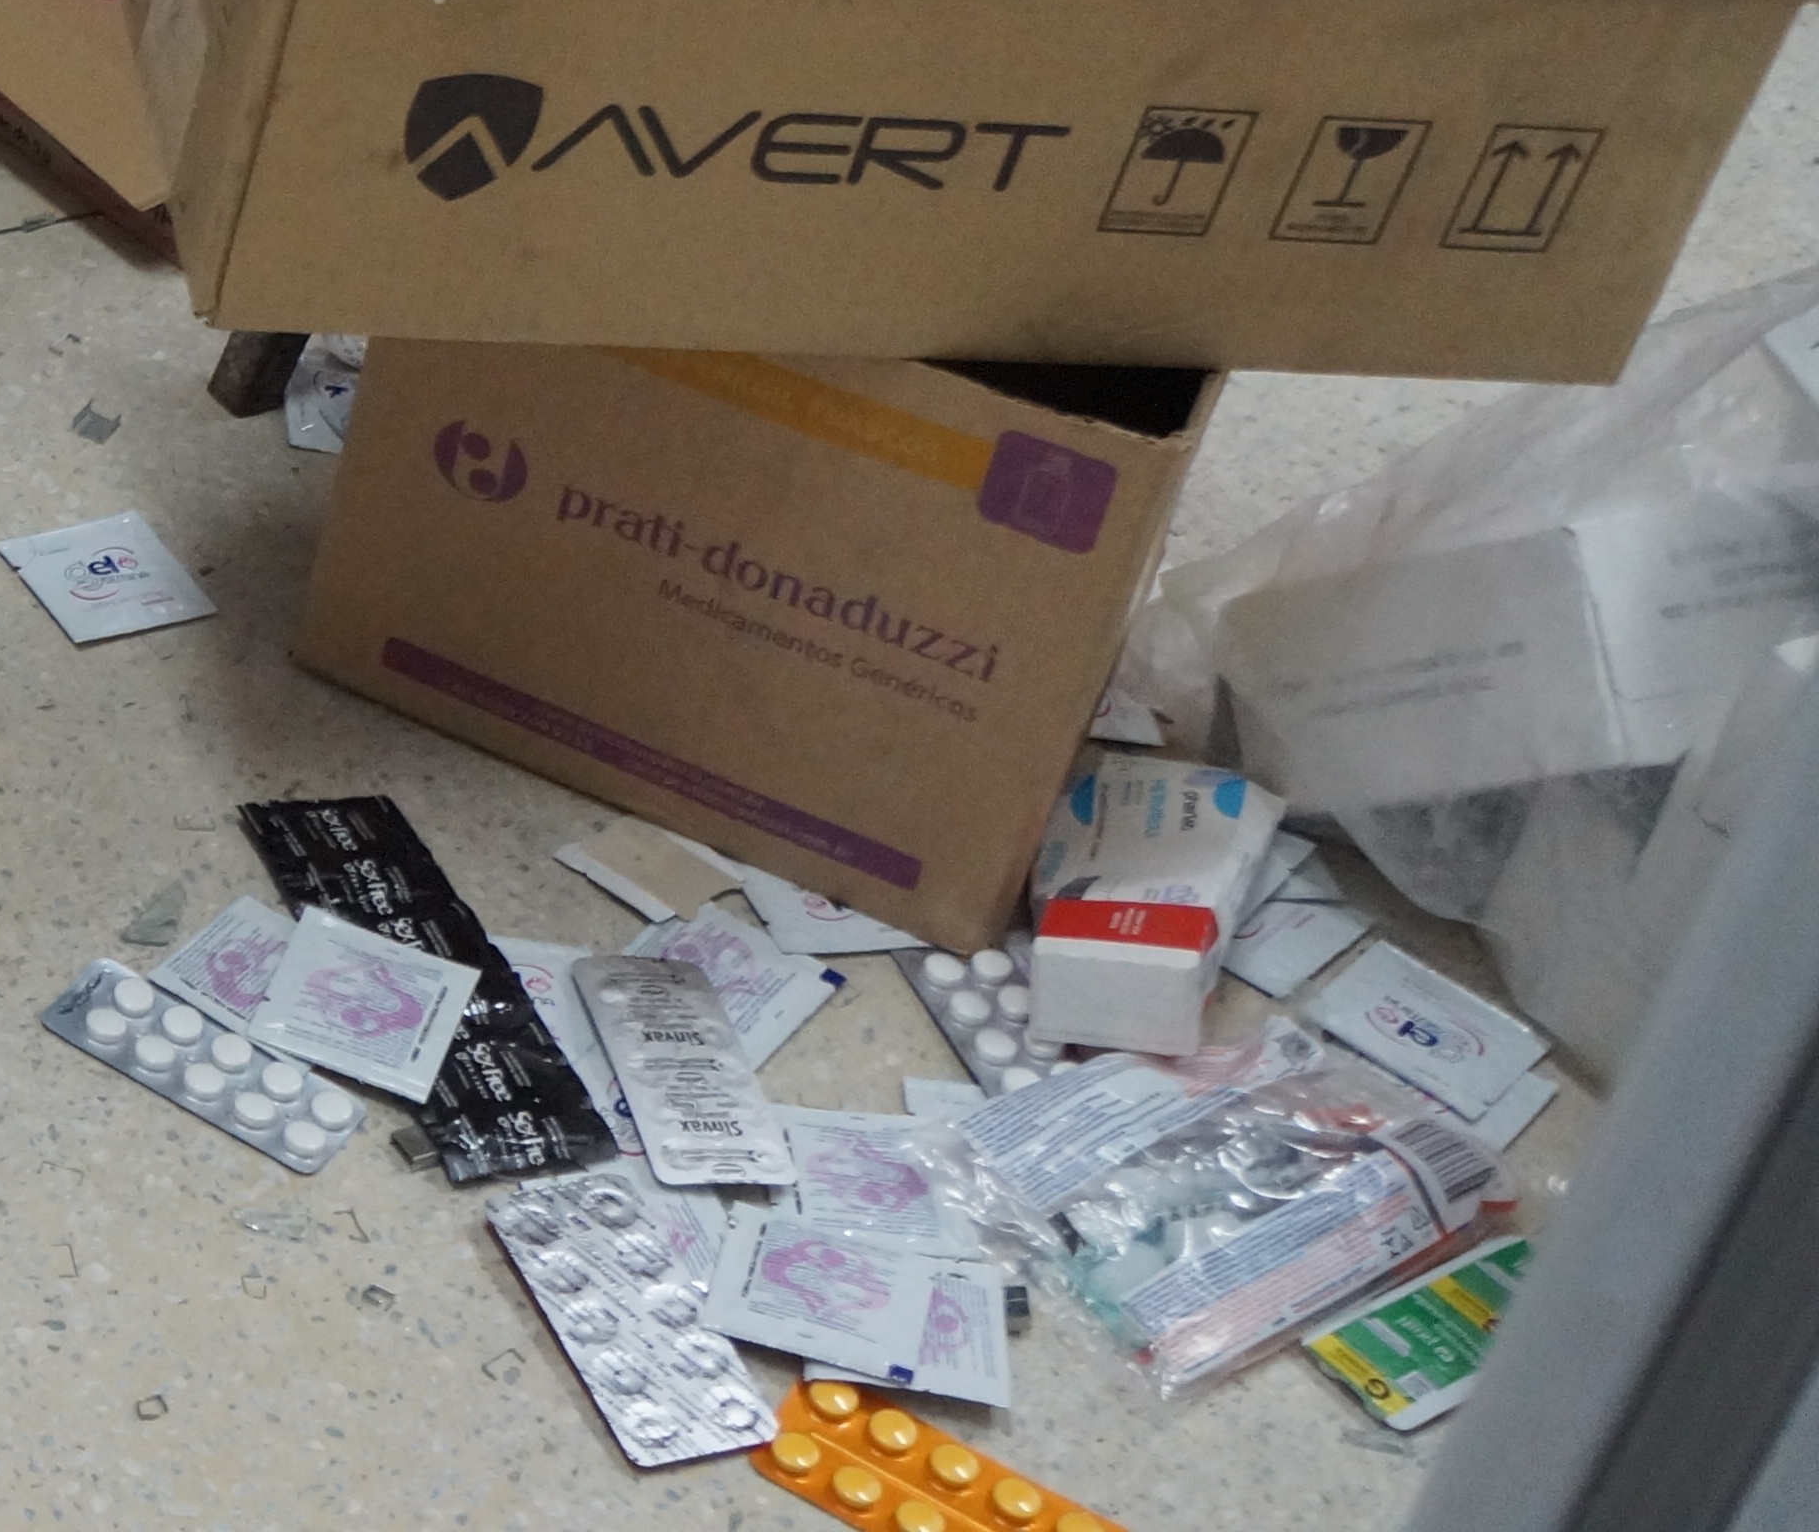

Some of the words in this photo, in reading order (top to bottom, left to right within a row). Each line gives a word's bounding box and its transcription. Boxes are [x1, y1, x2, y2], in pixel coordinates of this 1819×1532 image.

[533, 103, 1071, 194] AVERT
[556, 484, 1000, 682] prati-donaduzzi
[657, 579, 843, 668] Medicamentos
[850, 656, 978, 723] Genéricos
[642, 1031, 706, 1047] Sinvax
[680, 1119, 744, 1137] Sinvax
